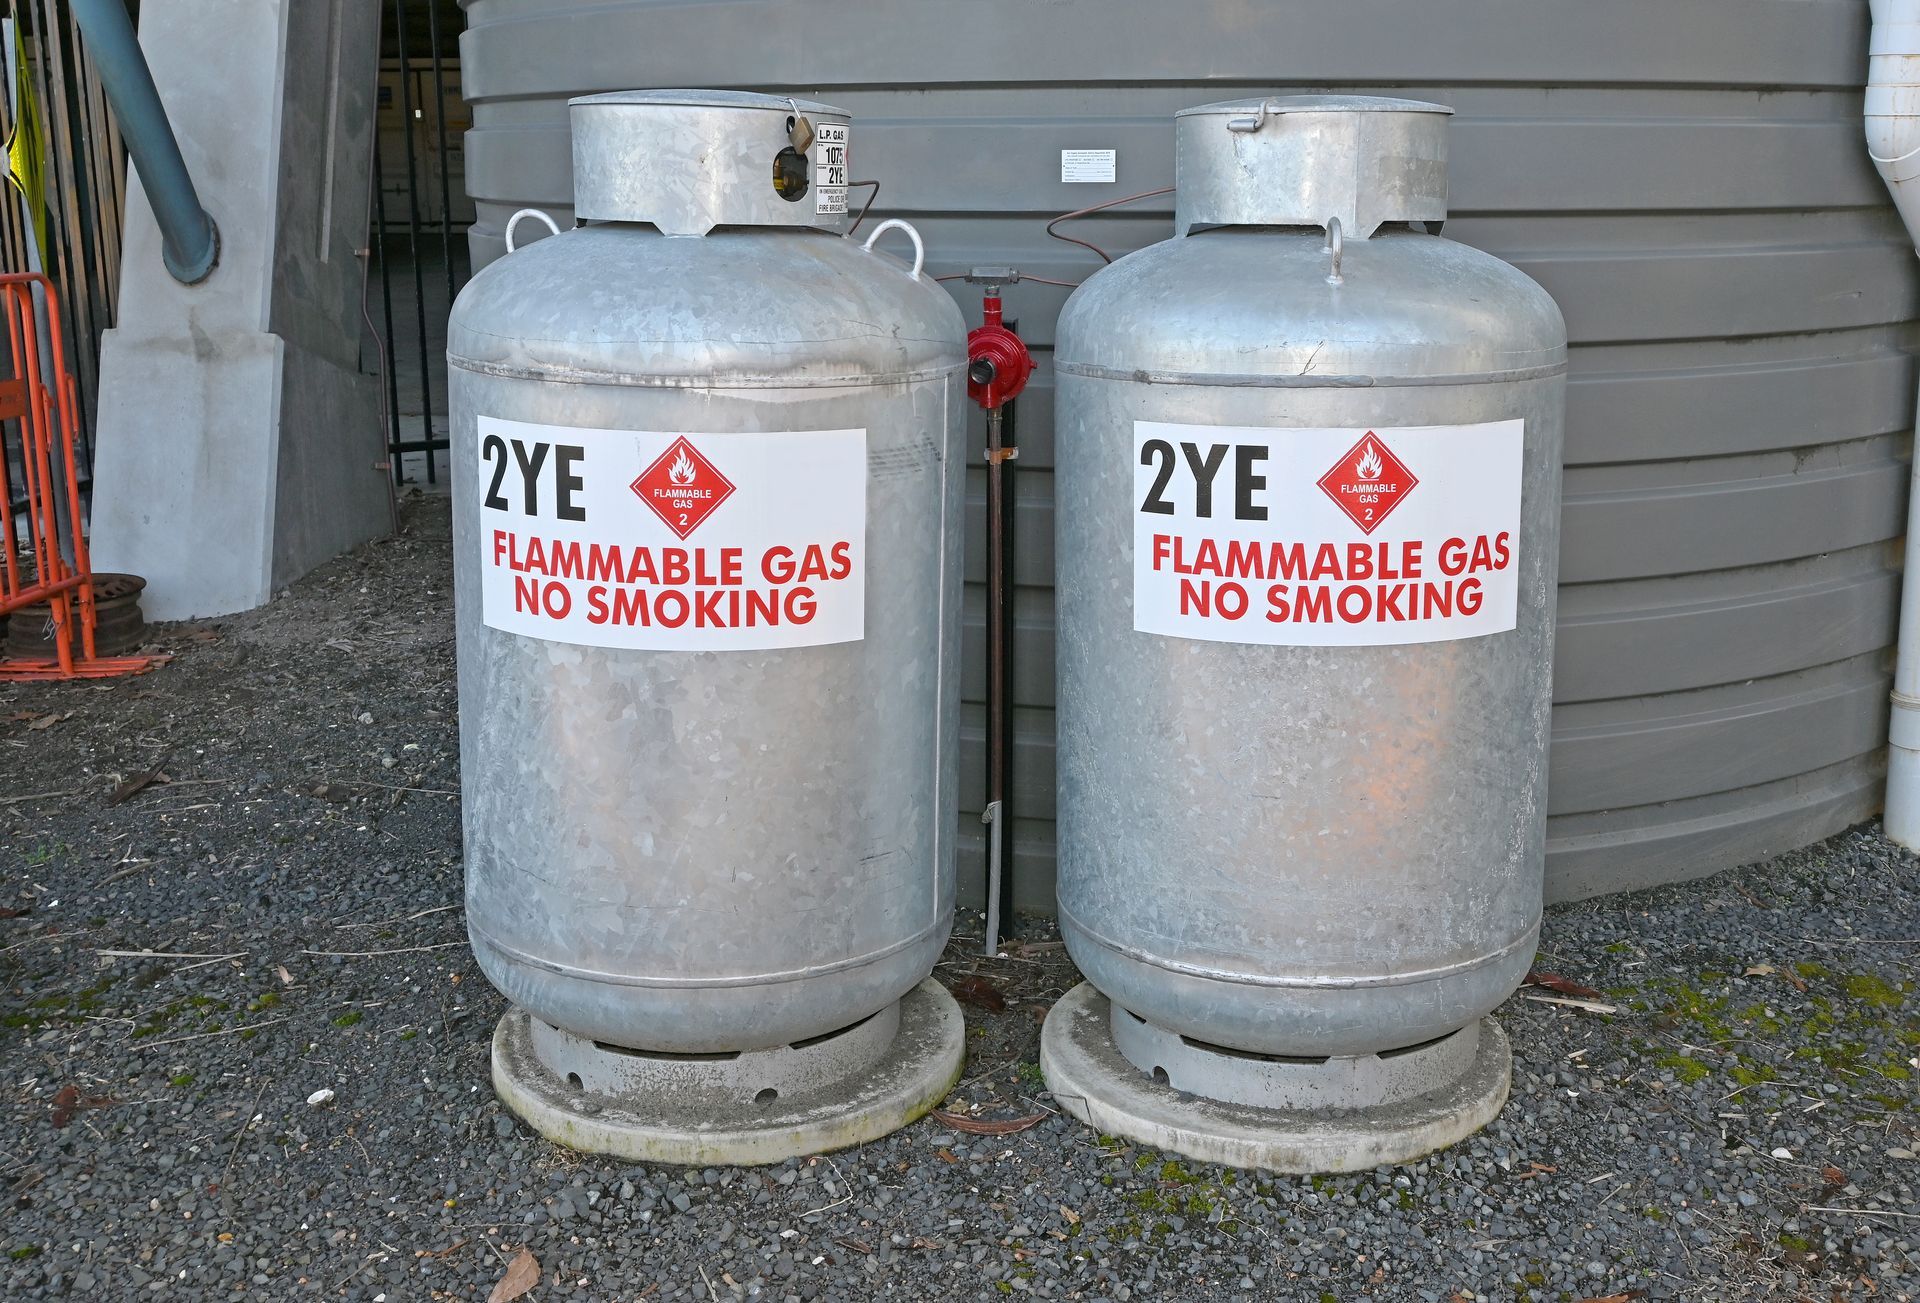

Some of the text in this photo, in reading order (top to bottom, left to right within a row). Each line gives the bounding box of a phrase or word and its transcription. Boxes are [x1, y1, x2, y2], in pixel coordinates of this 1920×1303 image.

[820, 130, 844, 140] L.P. GAS
[826, 147, 843, 164] 1075
[829, 166, 843, 184] 2YE
[828, 195, 840, 203] POLICE
[819, 204, 829, 212] FIRE
[483, 434, 586, 522] 2YE
[1140, 438, 1269, 521] 2YE
[654, 488, 712, 498] FLAMMABLE
[1341, 484, 1397, 493] FLAMMABLE
[673, 499, 693, 508] GAS
[1359, 494, 1379, 503] GAS
[679, 513, 688, 526] 2
[1364, 508, 1373, 520] 2
[493, 529, 852, 586] FLAMMABLE GAS
[1152, 531, 1510, 582] FLAMMABLE GAS
[514, 576, 818, 629] NO SMOKING
[1179, 577, 1484, 624] NO SMOKING
